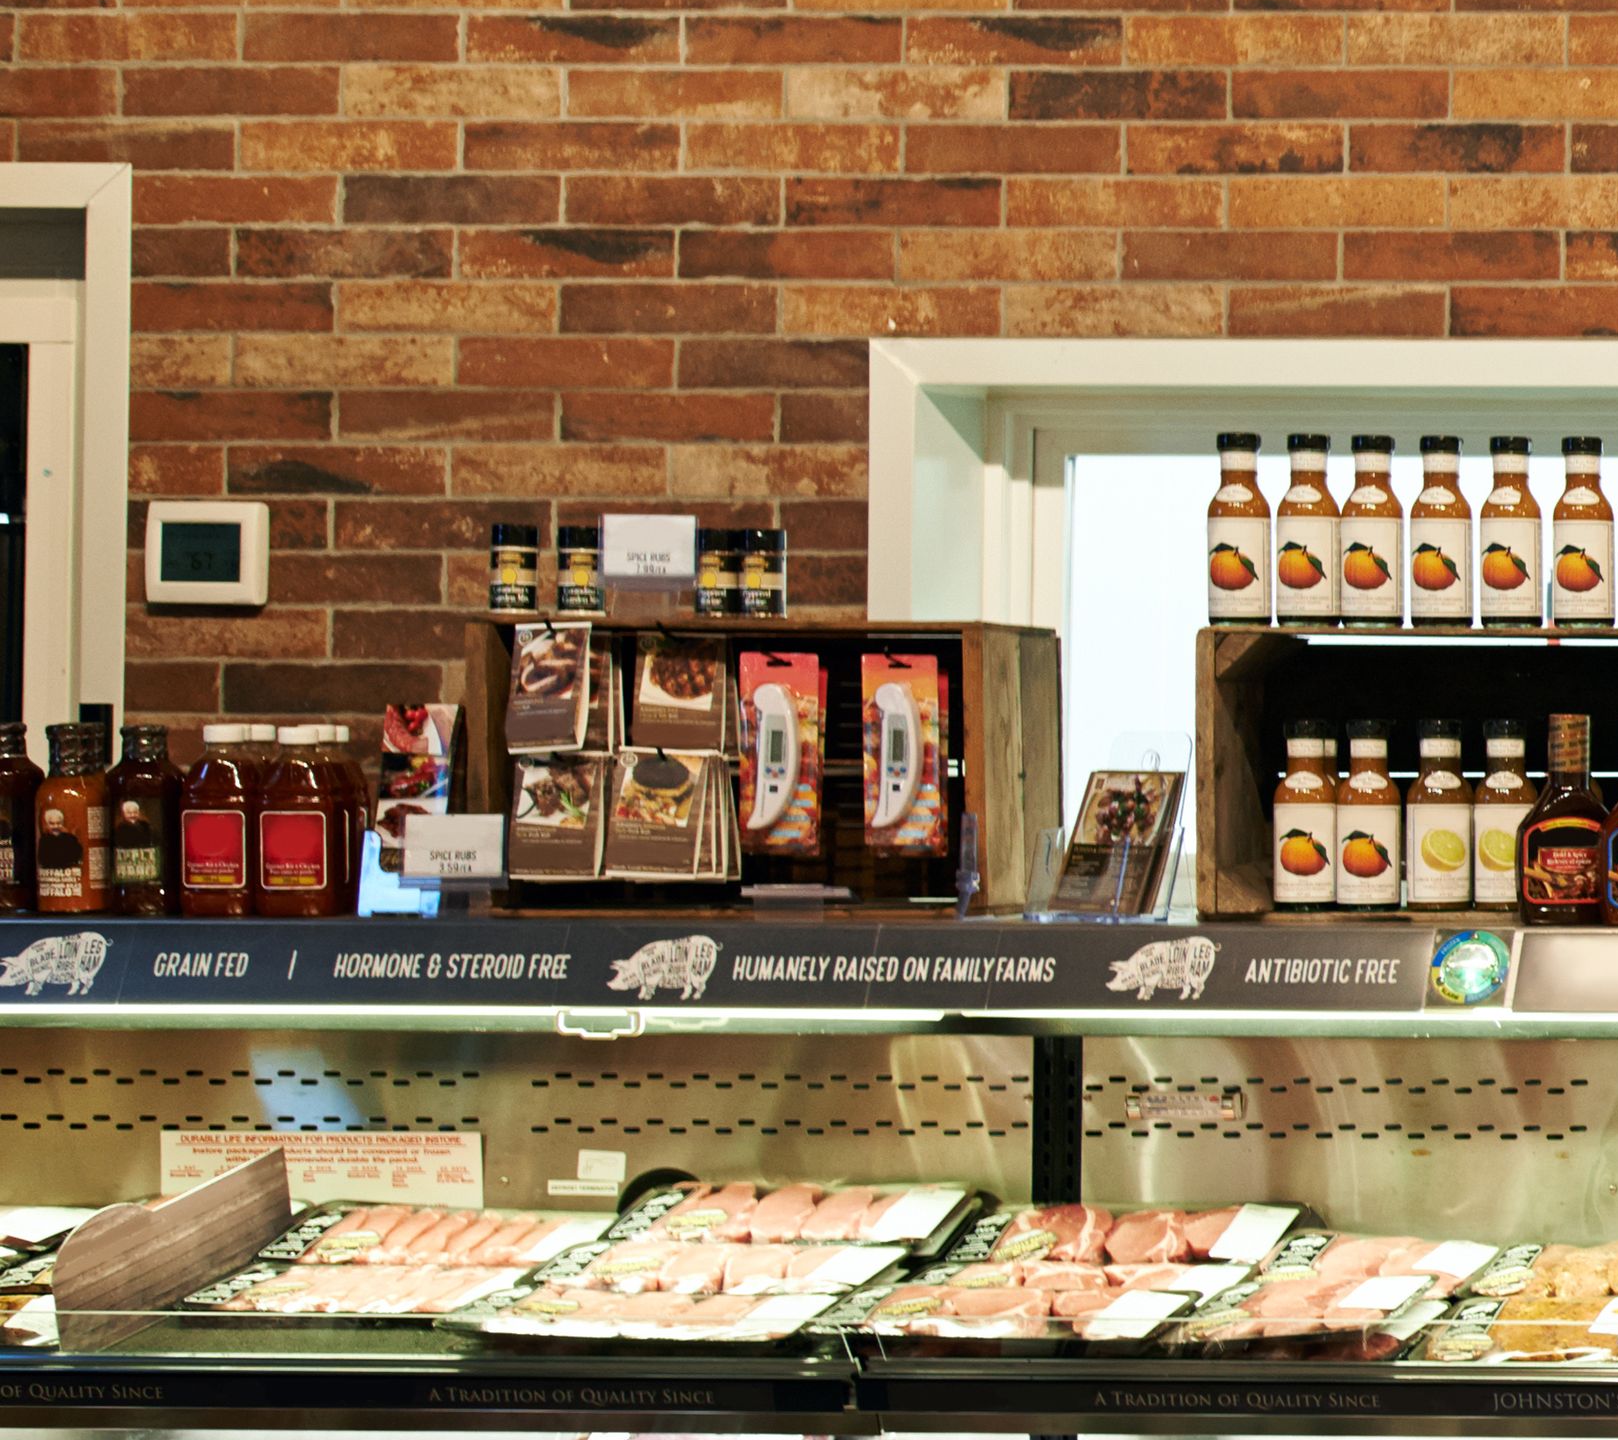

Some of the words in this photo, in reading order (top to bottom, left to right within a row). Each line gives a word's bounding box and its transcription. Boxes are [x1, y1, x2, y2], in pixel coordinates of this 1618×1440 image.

[430, 850, 452, 860] SPICE
[455, 851, 477, 860] RUBS
[153, 952, 208, 977] GRAIN
[212, 952, 249, 977] FED
[333, 954, 425, 978] HORMONE
[427, 954, 441, 978] &
[446, 954, 523, 978] STEROID
[528, 954, 571, 979] FREE
[733, 955, 830, 982] HUMANELY
[833, 956, 898, 982] RAISED
[903, 956, 928, 982] ON
[933, 956, 994, 982] FAMILY
[996, 957, 1056, 983] FARMS
[1245, 958, 1349, 984] ANTIBIOTIC
[1356, 958, 1399, 984] FREE
[429, 1388, 441, 1403] A
[448, 1388, 546, 1403] TRADITION
[552, 1388, 573, 1403] OF
[580, 1388, 657, 1405] QUALITY
[663, 1388, 715, 1403] SINCE
[1094, 1391, 1106, 1407] A
[1109, 1391, 1211, 1407] TRADITION
[1218, 1391, 1240, 1407] OF
[1246, 1391, 1323, 1410] QUALITY
[1328, 1391, 1380, 1407] SINCE
